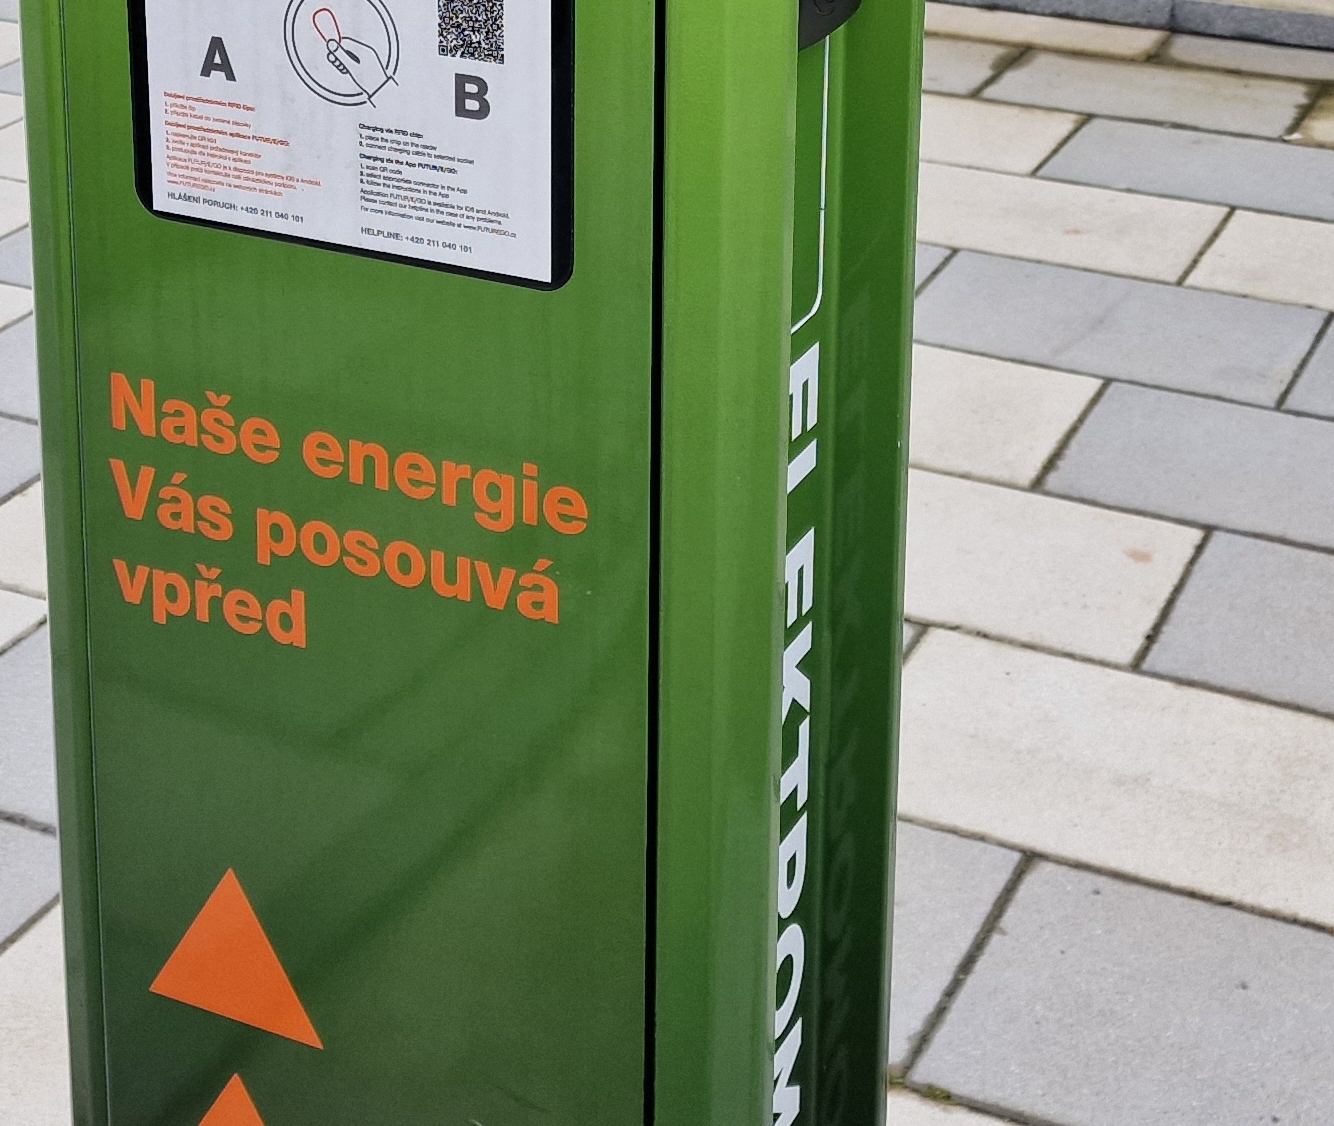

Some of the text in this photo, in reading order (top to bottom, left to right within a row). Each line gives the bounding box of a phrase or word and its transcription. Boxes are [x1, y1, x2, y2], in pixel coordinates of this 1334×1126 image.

[200, 36, 237, 82] A
[454, 72, 491, 121] B
[240, 206, 258, 215] +420
[260, 209, 272, 217] 211
[275, 212, 289, 220] 040
[291, 214, 303, 223] 101
[405, 236, 424, 244] +420
[427, 239, 439, 248] 211
[442, 242, 456, 250] 040
[458, 244, 472, 253] 101
[110, 371, 589, 535] Naše energie
[109, 458, 559, 624] Vás posouvá
[112, 558, 307, 649] vpřed
